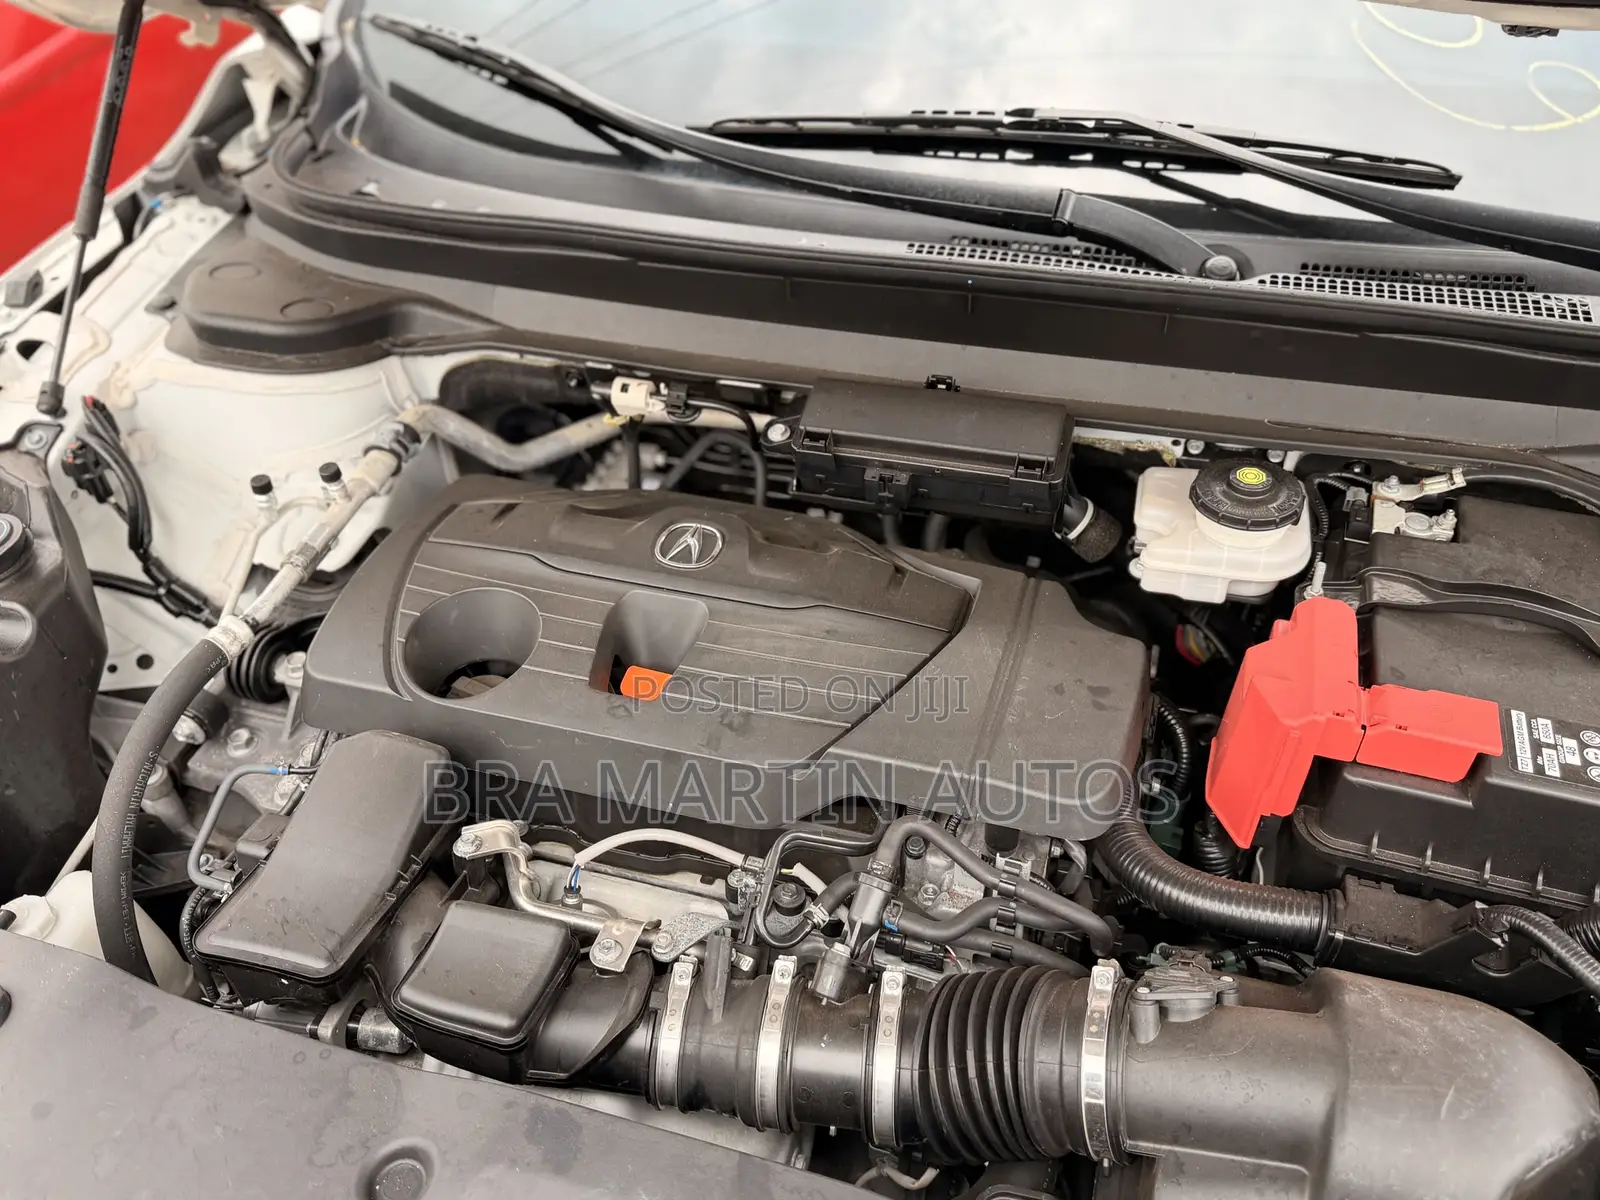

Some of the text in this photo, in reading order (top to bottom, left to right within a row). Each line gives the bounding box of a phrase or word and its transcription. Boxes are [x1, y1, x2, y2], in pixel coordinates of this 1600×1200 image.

[1515, 712, 1524, 731] Battery
[1557, 745, 1566, 764] GROUP
[1565, 746, 1577, 757] 48
